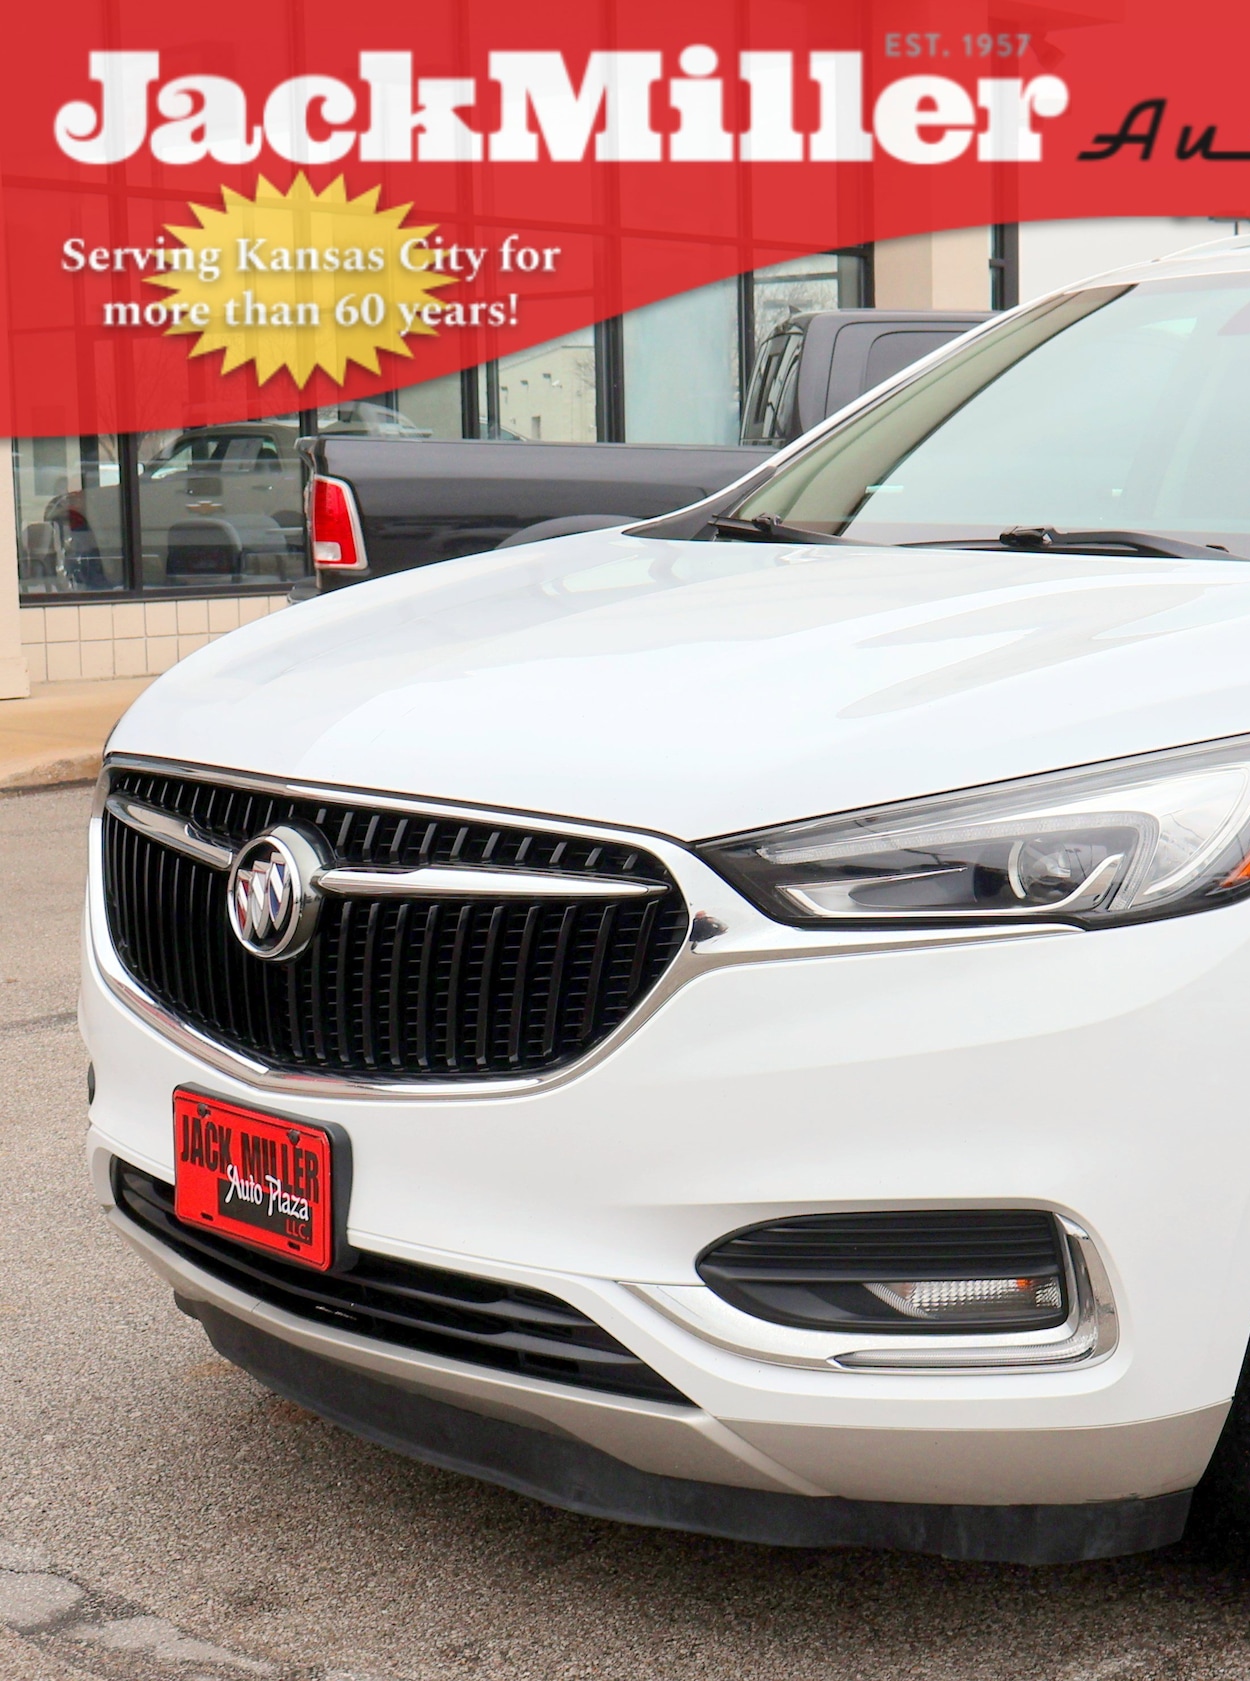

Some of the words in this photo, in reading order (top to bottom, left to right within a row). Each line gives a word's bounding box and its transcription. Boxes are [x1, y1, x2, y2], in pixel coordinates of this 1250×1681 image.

[181, 1114, 233, 1175] JACK
[240, 1131, 320, 1204] MILLER
[225, 1164, 263, 1204] Auto
[265, 1174, 310, 1222] Plaza
